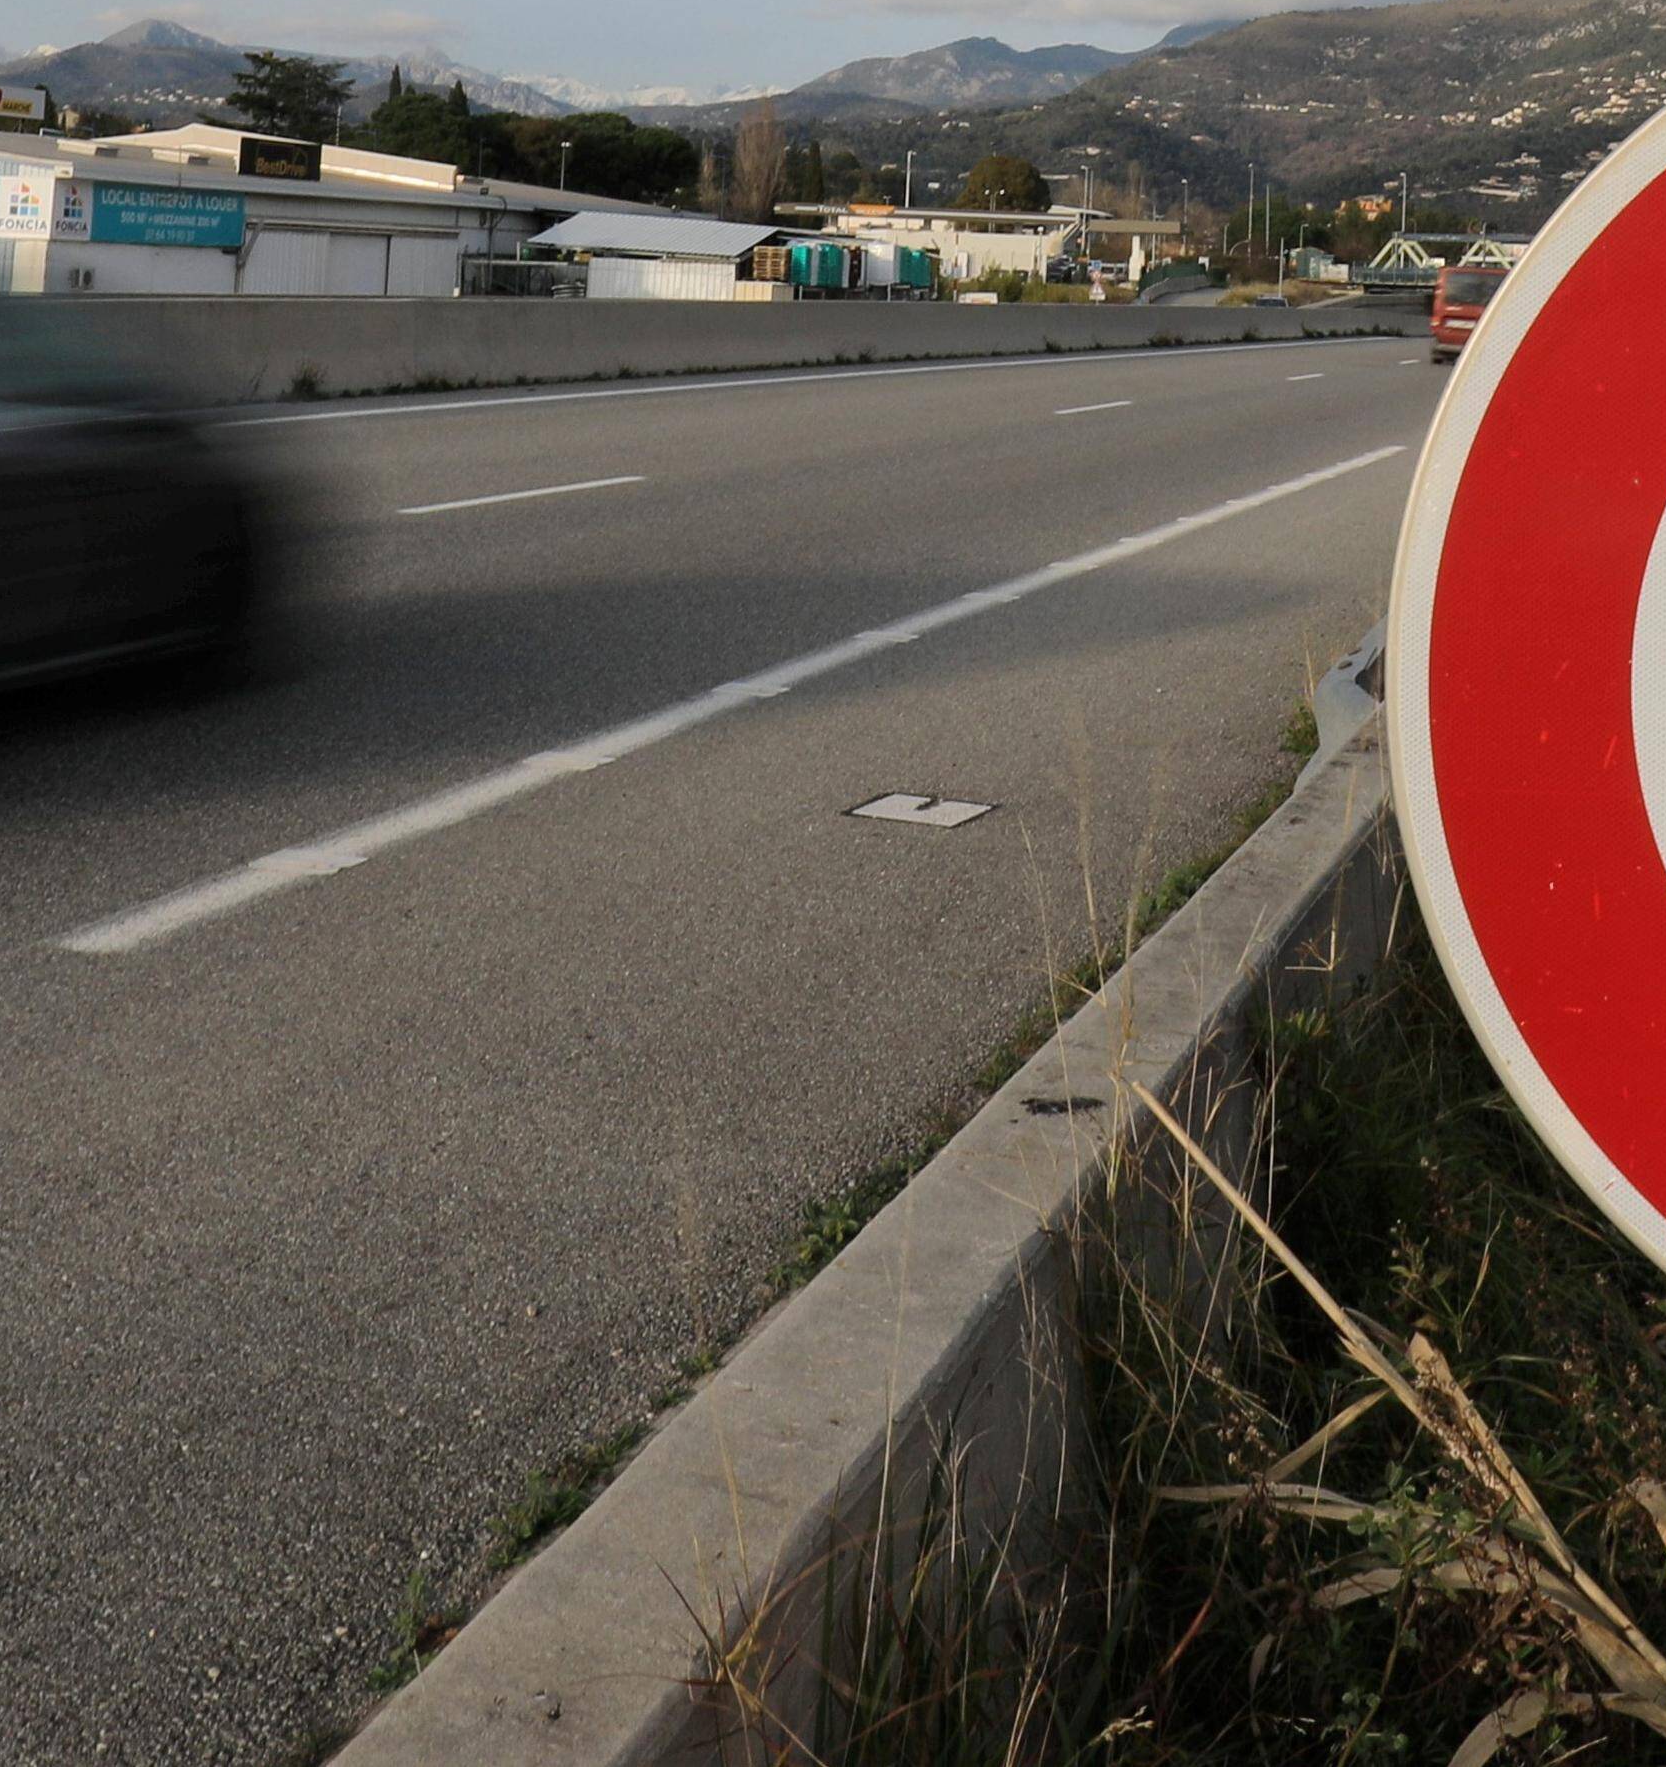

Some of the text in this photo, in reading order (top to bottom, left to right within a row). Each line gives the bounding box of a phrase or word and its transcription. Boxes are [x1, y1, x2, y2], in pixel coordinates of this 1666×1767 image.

[101, 189, 136, 207] LOCAL
[205, 195, 238, 212] LOUER
[818, 204, 849, 214] TOTAL
[55, 220, 88, 232] FONCIA
